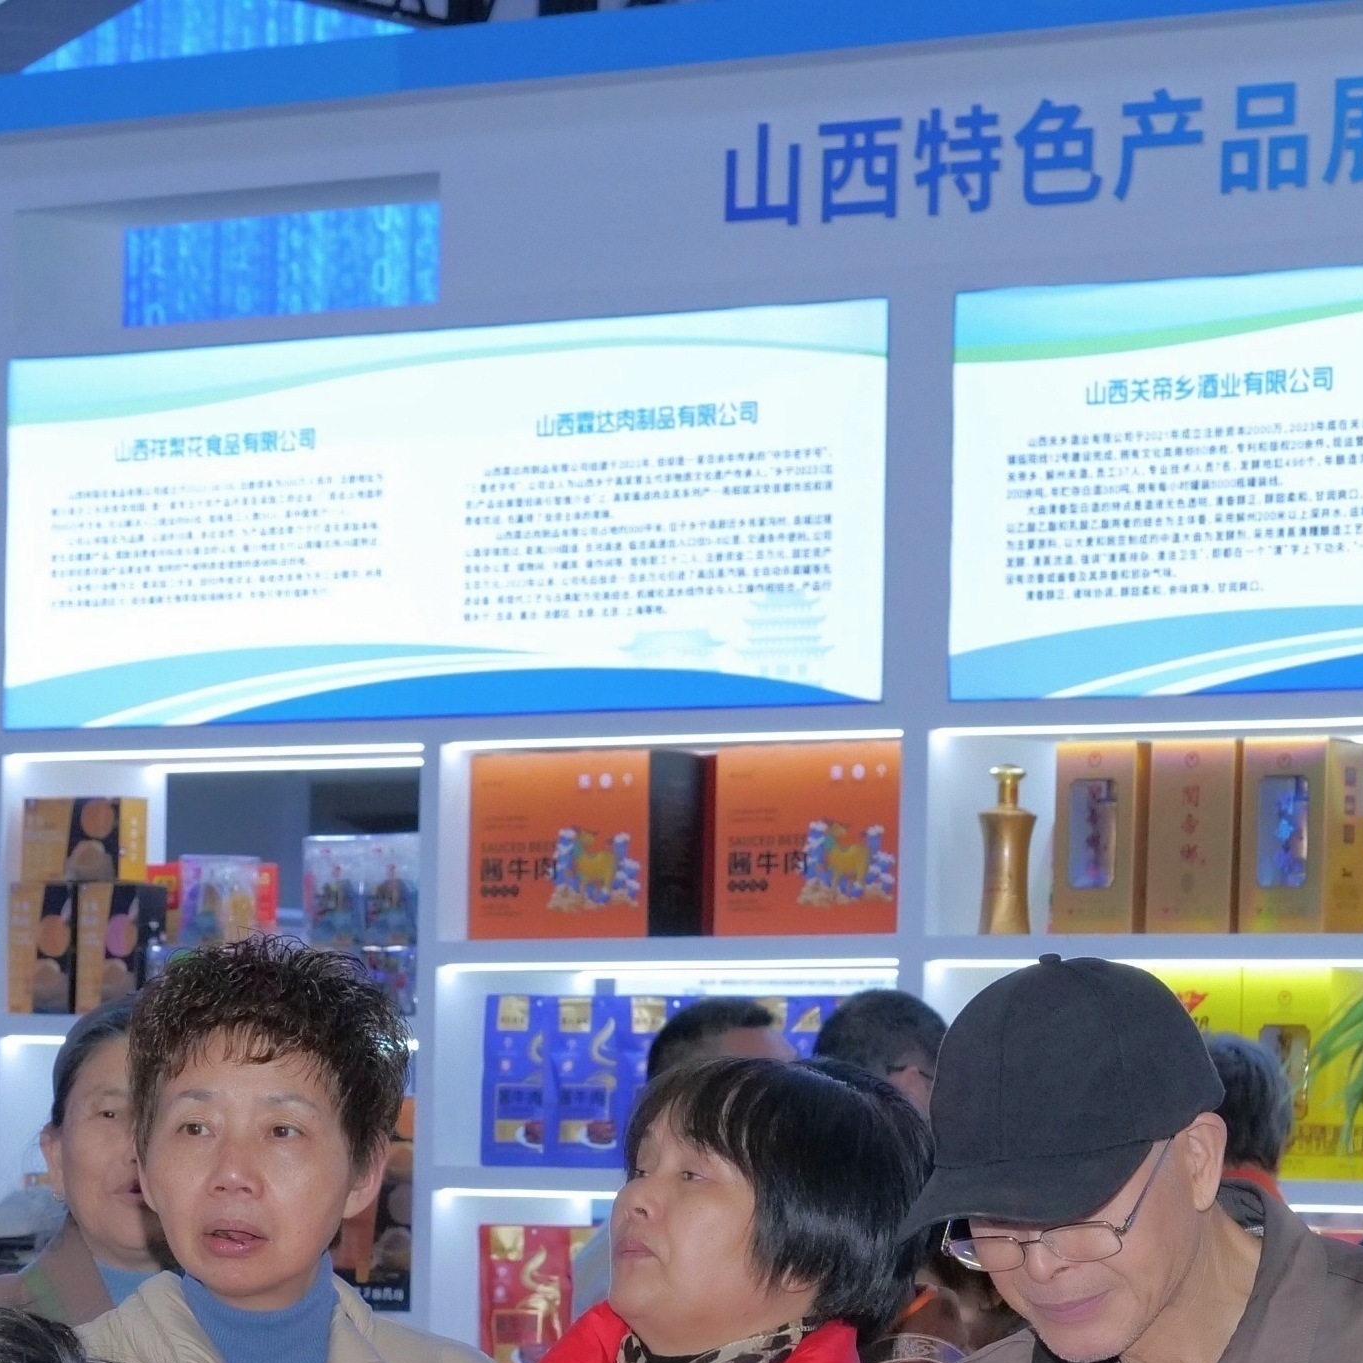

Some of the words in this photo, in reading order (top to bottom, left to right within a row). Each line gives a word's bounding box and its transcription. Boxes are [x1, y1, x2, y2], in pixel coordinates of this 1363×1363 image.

[1085, 366, 1333, 406] 山西关帝乡酒业有限公司
[481, 855, 557, 882] 酱牛肉
[728, 850, 808, 877] 酱牛肉
